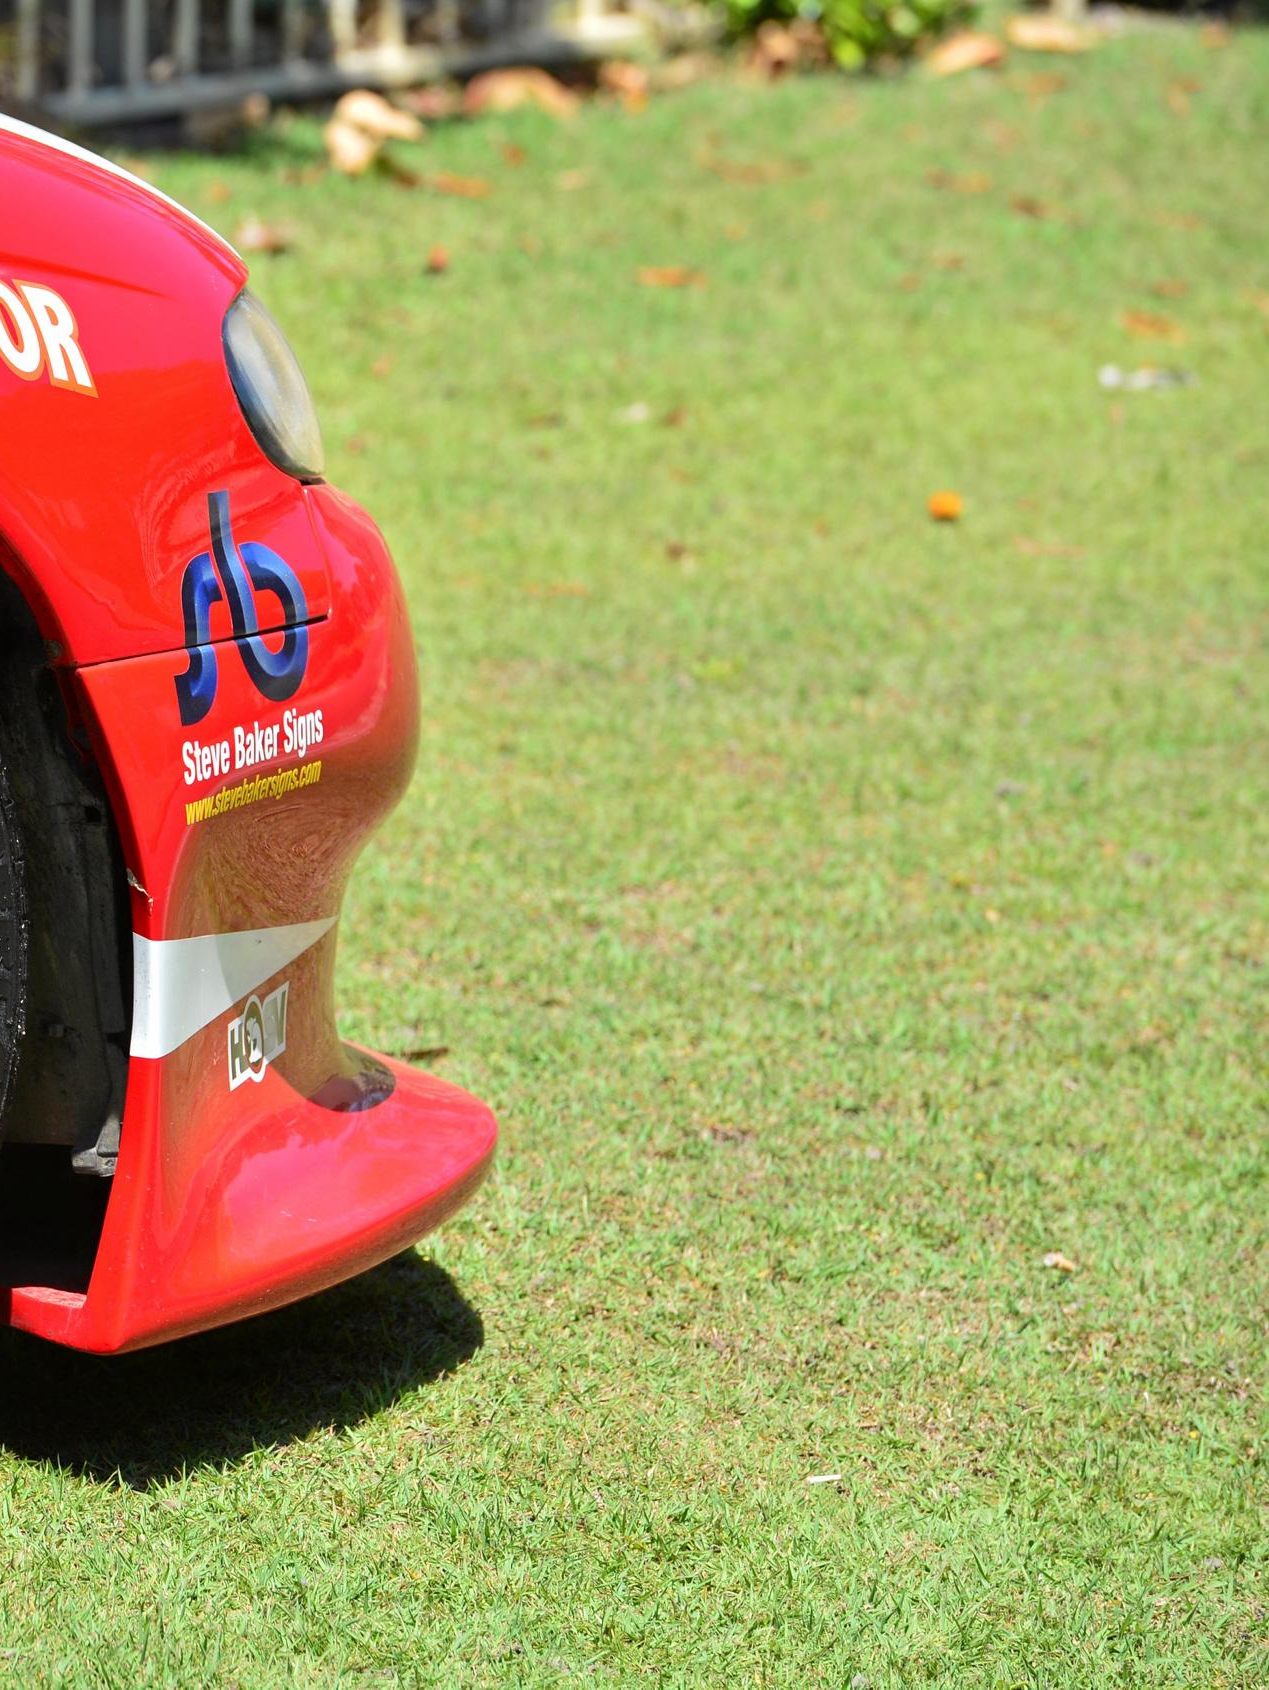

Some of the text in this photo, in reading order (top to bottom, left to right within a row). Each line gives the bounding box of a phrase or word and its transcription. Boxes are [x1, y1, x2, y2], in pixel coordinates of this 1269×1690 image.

[182, 708, 324, 786] Steve Baker Signs
[185, 760, 323, 826] www.stevebakersigns.com
